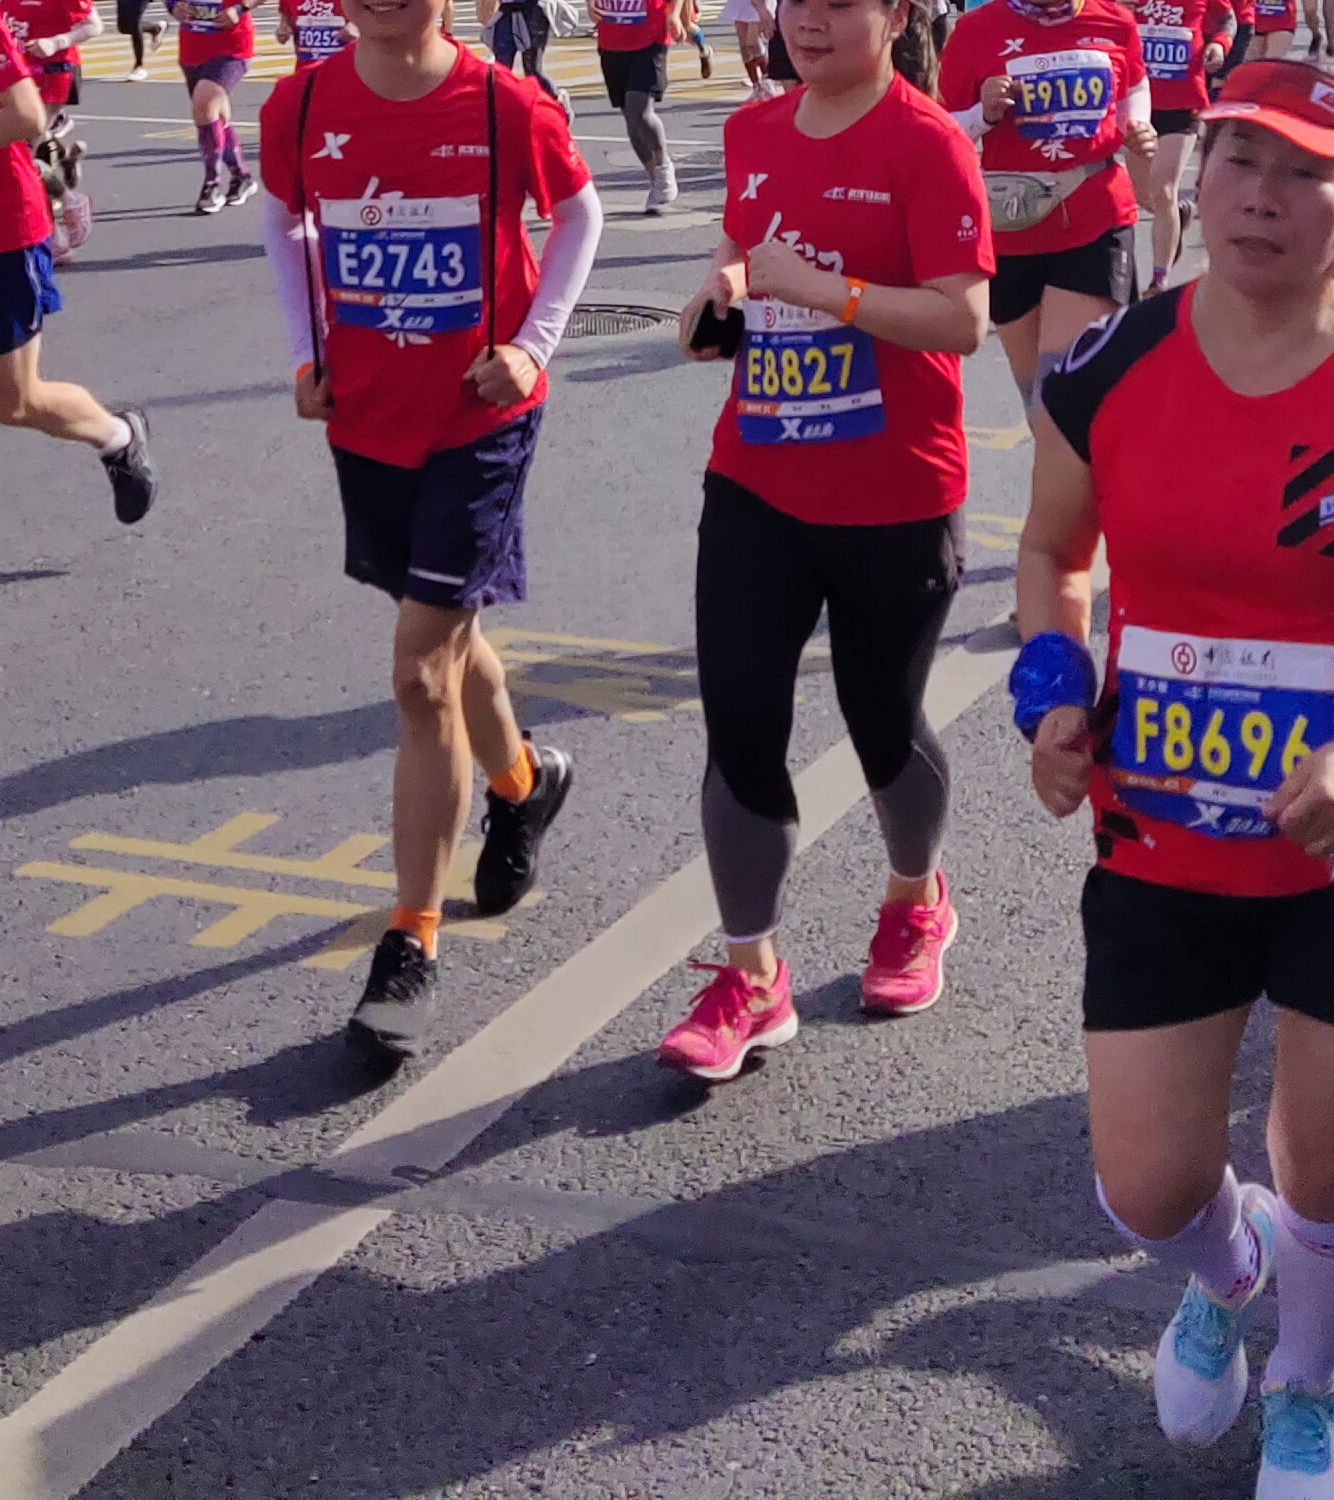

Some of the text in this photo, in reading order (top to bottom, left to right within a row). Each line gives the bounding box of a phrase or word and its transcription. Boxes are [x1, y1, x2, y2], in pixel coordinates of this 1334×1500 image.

[299, 30, 340, 47] F0252
[1140, 43, 1187, 63] 1010
[1020, 74, 1104, 113] F9169
[337, 241, 466, 288] E2743
[746, 342, 855, 397] E8827
[1133, 697, 1314, 782] F8696
